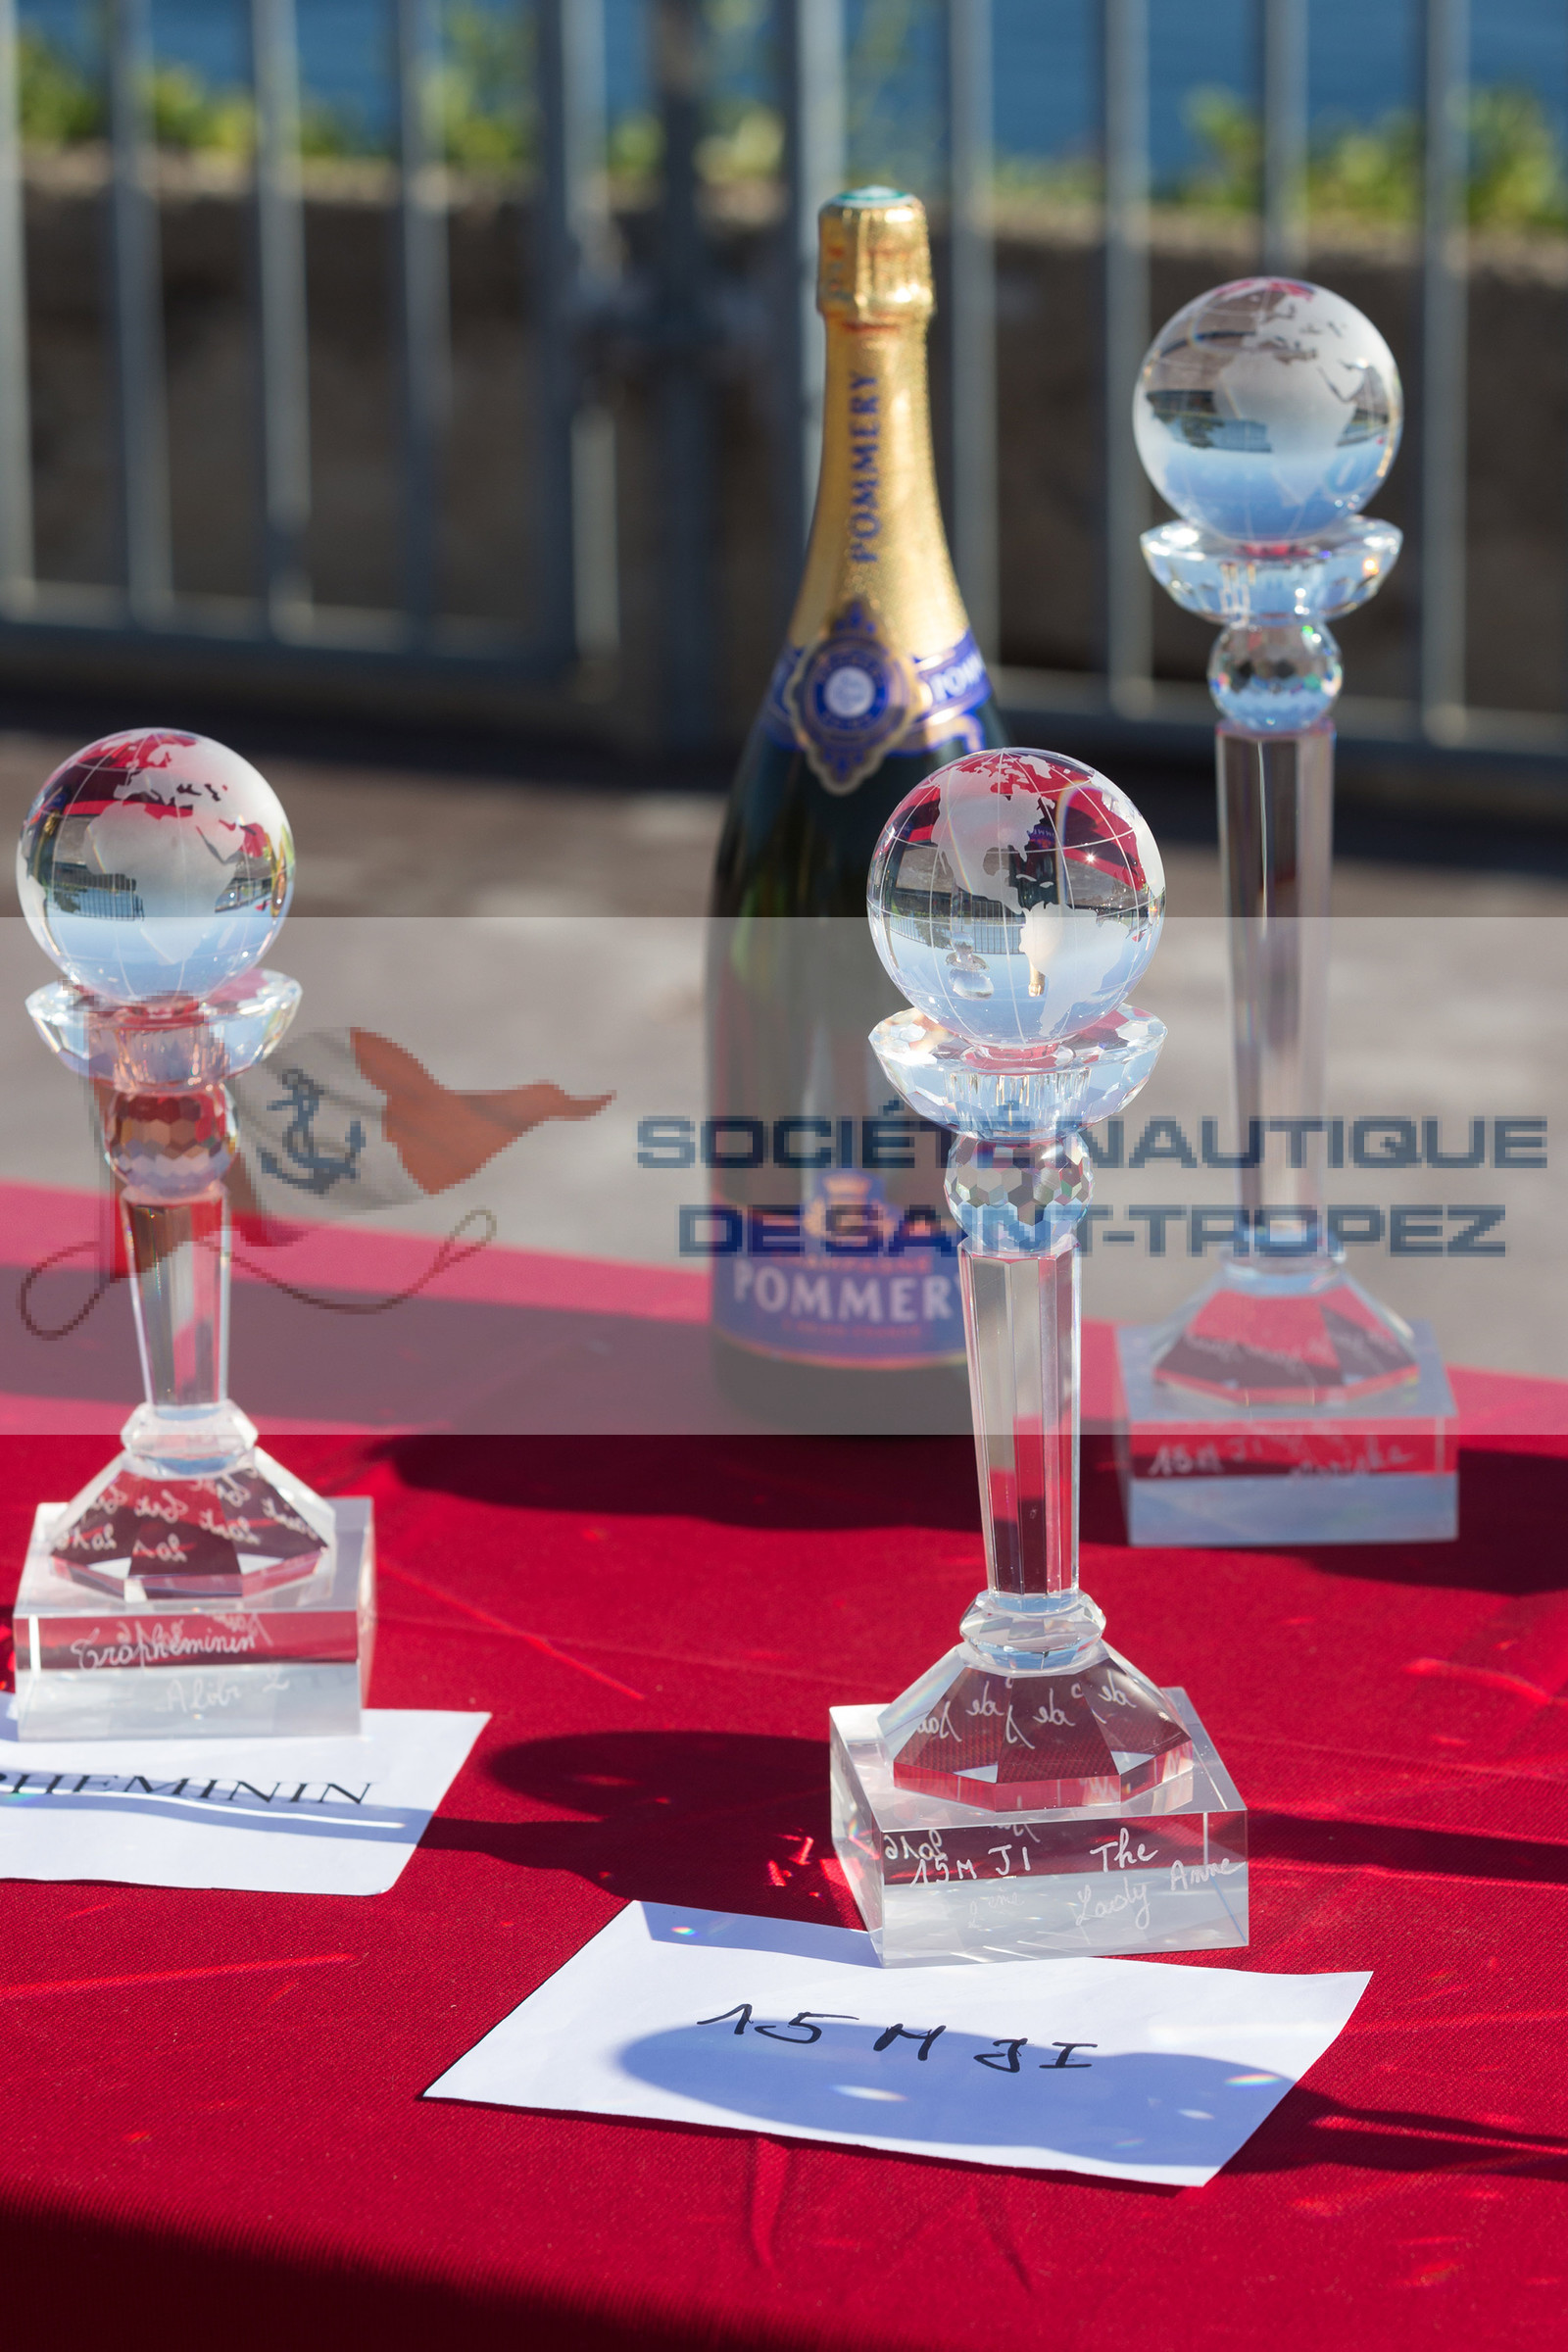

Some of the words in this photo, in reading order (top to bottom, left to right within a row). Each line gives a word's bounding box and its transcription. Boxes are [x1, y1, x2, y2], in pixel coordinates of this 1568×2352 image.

[849, 370, 882, 564] POMMERY
[733, 1258, 963, 1323] POMMER
[1089, 1827, 1159, 1873] The
[697, 2003, 860, 2045] 15
